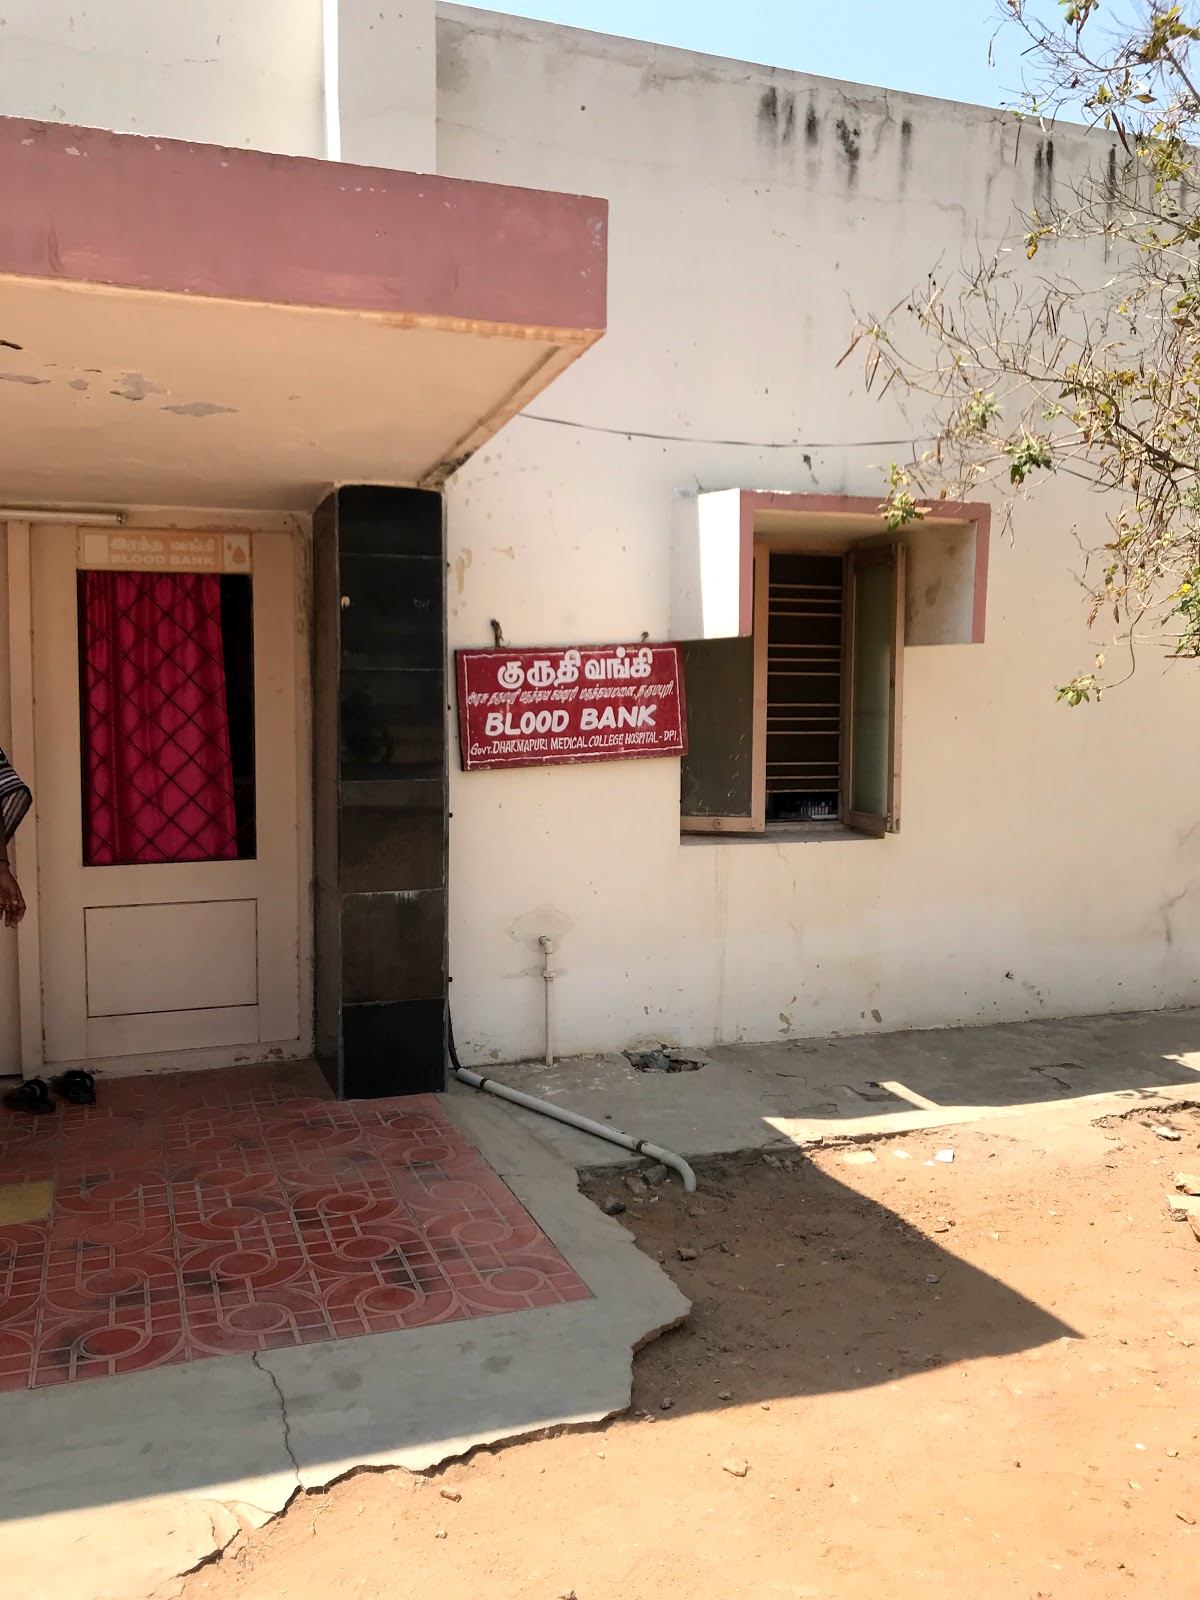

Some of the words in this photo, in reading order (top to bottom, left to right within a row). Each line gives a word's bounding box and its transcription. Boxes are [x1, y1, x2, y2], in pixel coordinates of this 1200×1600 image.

[110, 554, 165, 564] BLOOD
[170, 555, 214, 566] BANK
[498, 650, 581, 689] குருதி
[585, 647, 653, 680] வங்கி
[485, 710, 569, 736] BLOOD
[580, 705, 657, 730] BANK
[492, 739, 548, 754] DHARMAPURI
[550, 735, 588, 750] MEDICAL
[588, 733, 623, 748] COLLEGE
